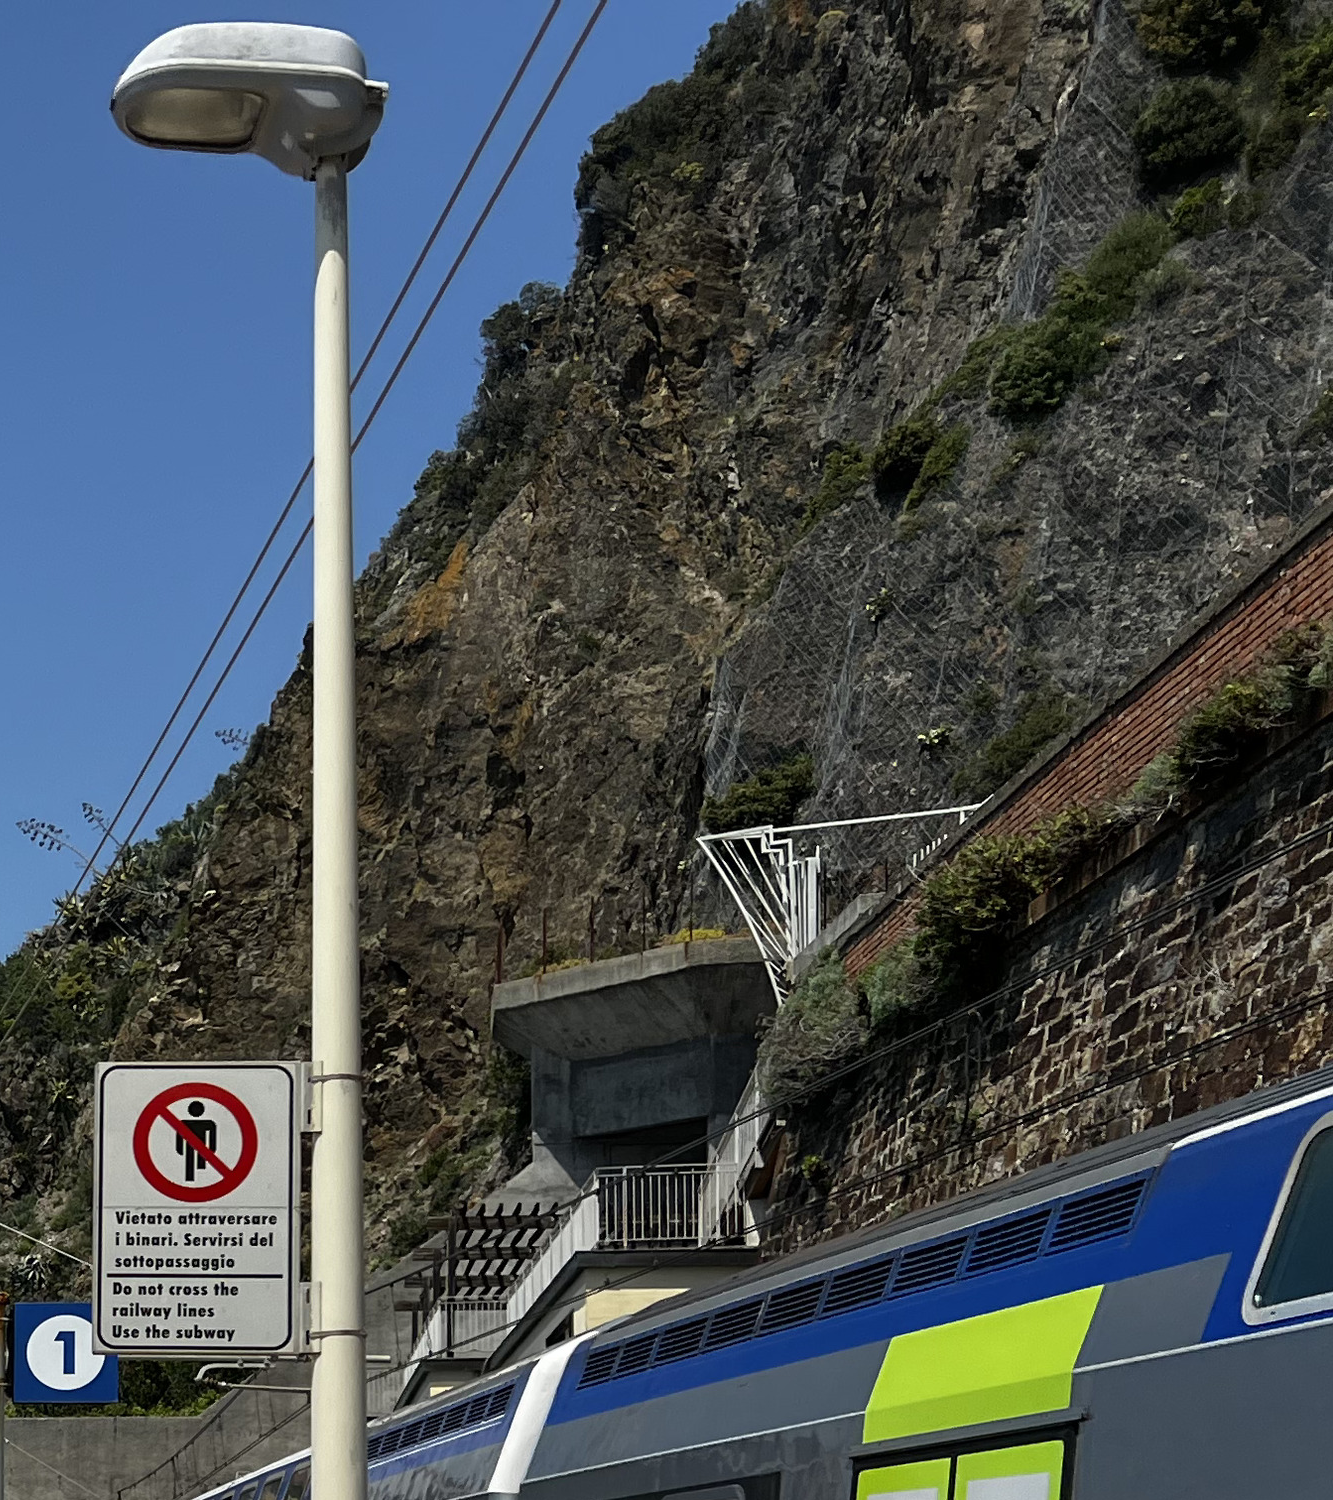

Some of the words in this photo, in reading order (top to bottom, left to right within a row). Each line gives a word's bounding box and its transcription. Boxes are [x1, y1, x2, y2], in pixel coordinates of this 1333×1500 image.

[115, 1210, 172, 1225] Vietato
[178, 1211, 278, 1225] attraversare
[115, 1231, 120, 1246] i
[126, 1231, 178, 1246] binari.
[183, 1232, 244, 1247] Servirsi
[249, 1232, 274, 1247] del
[115, 1254, 235, 1271] sottopassaggio
[112, 1282, 132, 1295] Do
[138, 1283, 163, 1295] not
[169, 1284, 208, 1296] cross
[214, 1281, 239, 1296] the
[112, 1303, 172, 1320] railway
[177, 1303, 215, 1317] lines
[112, 1325, 139, 1339] Use
[145, 1324, 170, 1339] the
[176, 1325, 235, 1342] subway
[54, 1330, 76, 1375] 1
